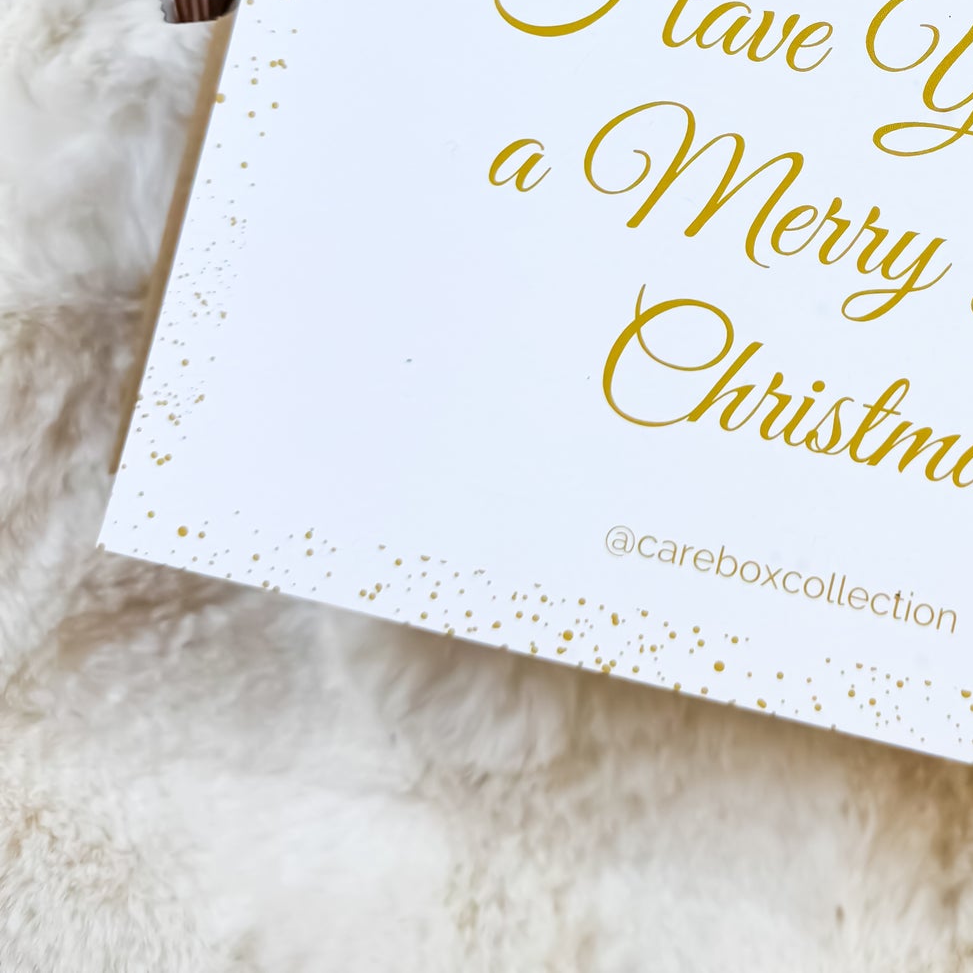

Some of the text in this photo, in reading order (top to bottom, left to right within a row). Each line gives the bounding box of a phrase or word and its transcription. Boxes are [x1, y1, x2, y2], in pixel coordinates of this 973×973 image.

[488, 138, 552, 193] a
[583, 101, 952, 323] Merry
[605, 524, 958, 634] @careboxcollection
